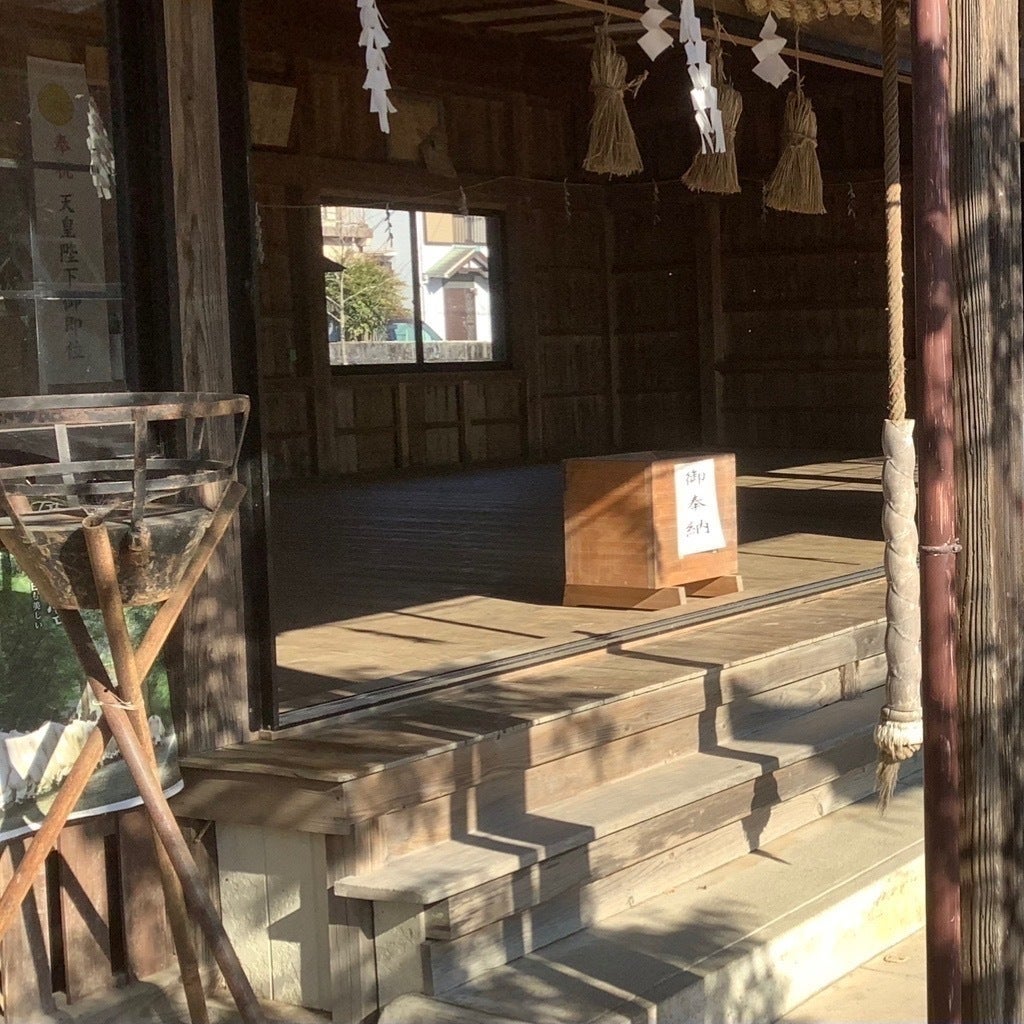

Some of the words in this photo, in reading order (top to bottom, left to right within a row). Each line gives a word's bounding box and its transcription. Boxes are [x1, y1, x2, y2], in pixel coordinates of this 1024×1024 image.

[59, 193, 86, 360] 天皇陛下御即位
[685, 470, 710, 537] 御奉納
